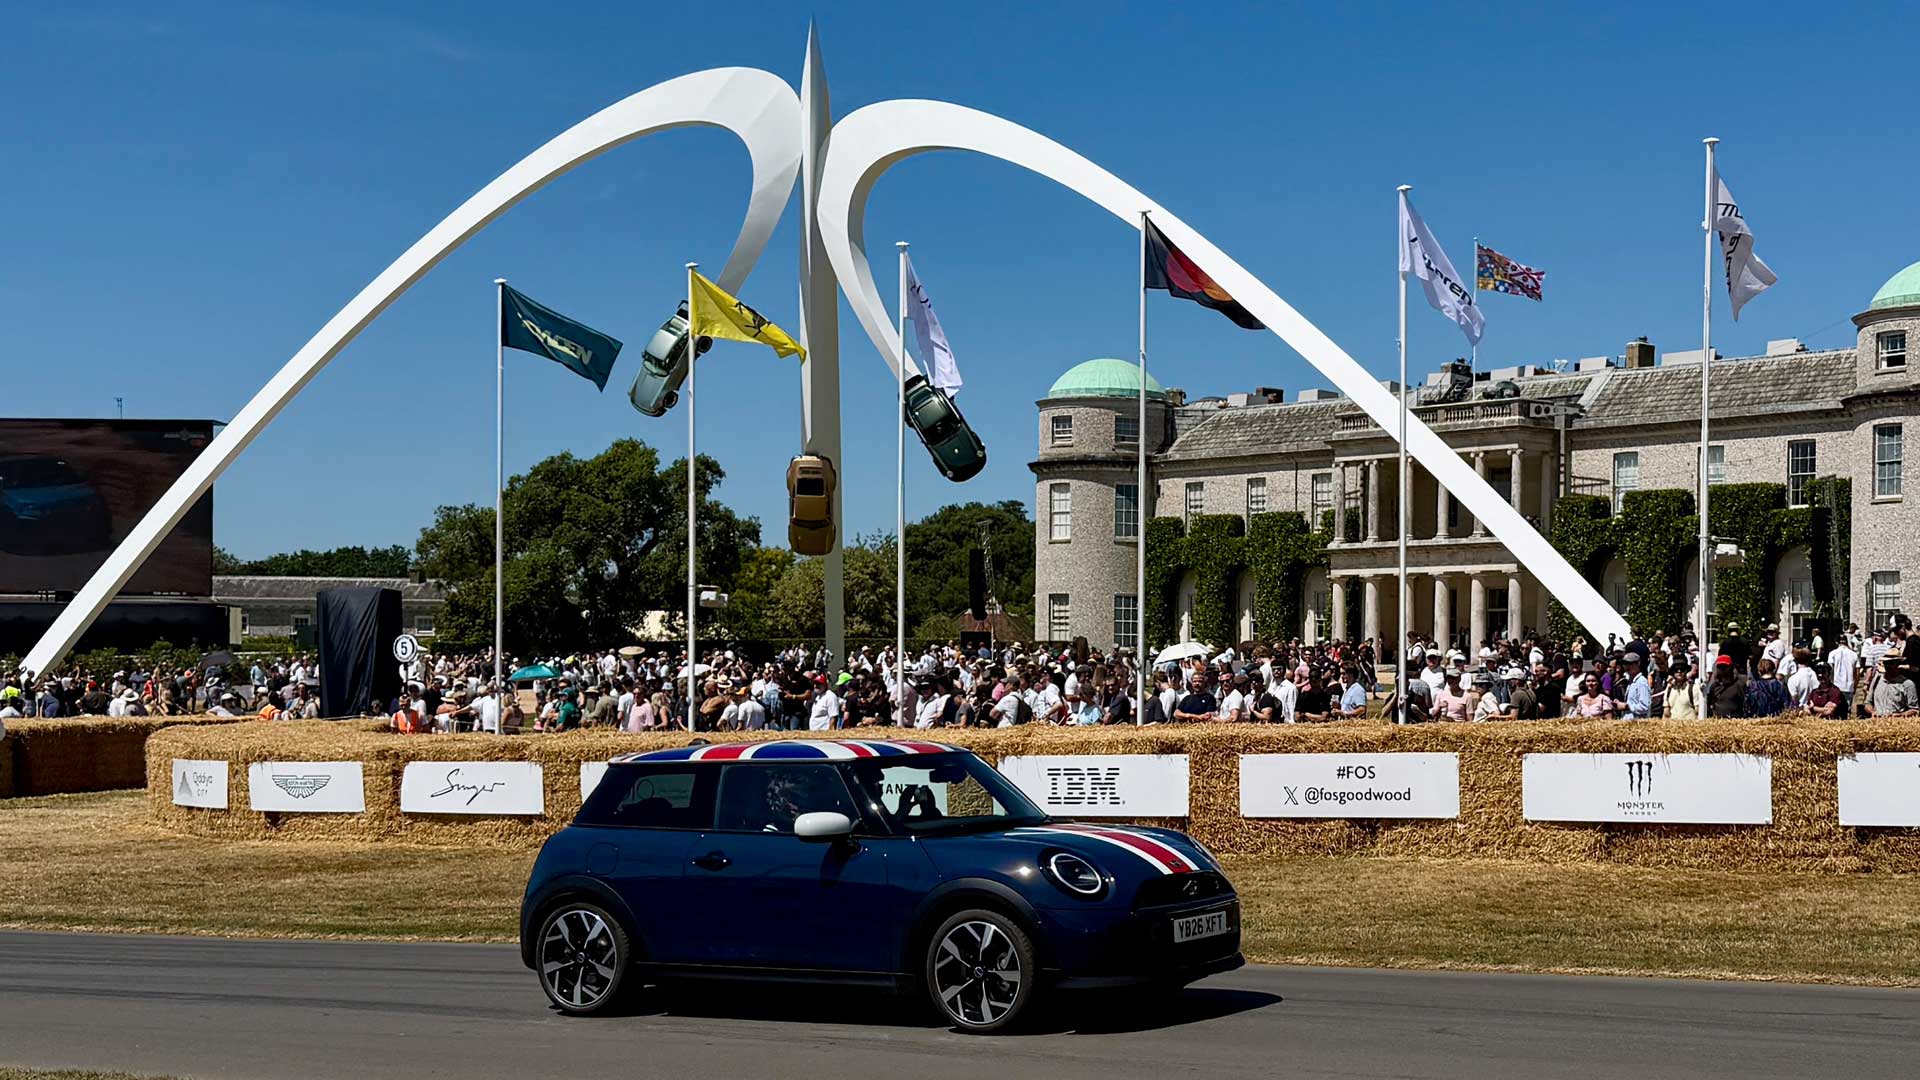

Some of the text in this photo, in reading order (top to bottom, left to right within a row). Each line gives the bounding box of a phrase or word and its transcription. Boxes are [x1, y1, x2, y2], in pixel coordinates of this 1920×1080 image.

[401, 641, 408, 656] 5
[1336, 766, 1376, 780] #FOS
[430, 768, 505, 806] Singer
[1047, 767, 1121, 805] IBM
[1304, 787, 1411, 805] @fosgoodwood
[1617, 801, 1665, 810] MONSTER
[1178, 913, 1223, 939] YB26 XFT
